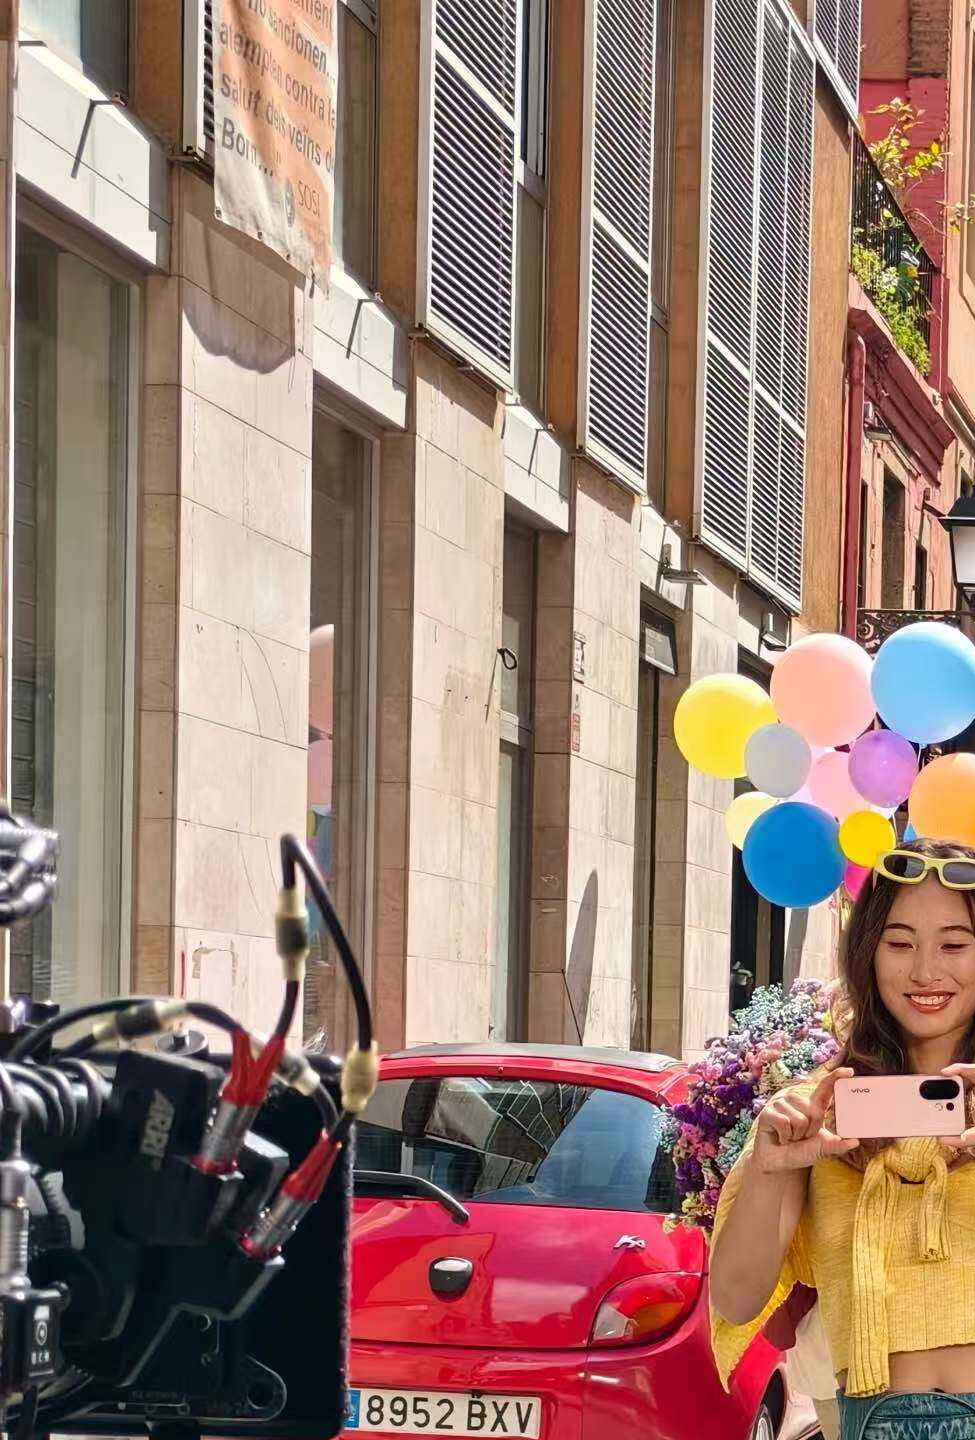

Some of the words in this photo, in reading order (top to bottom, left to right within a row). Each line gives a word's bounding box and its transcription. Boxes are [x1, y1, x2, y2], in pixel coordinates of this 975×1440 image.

[284, 73, 325, 121] contra
[366, 1395, 454, 1430] 8952
[466, 1399, 533, 1434] BXV
